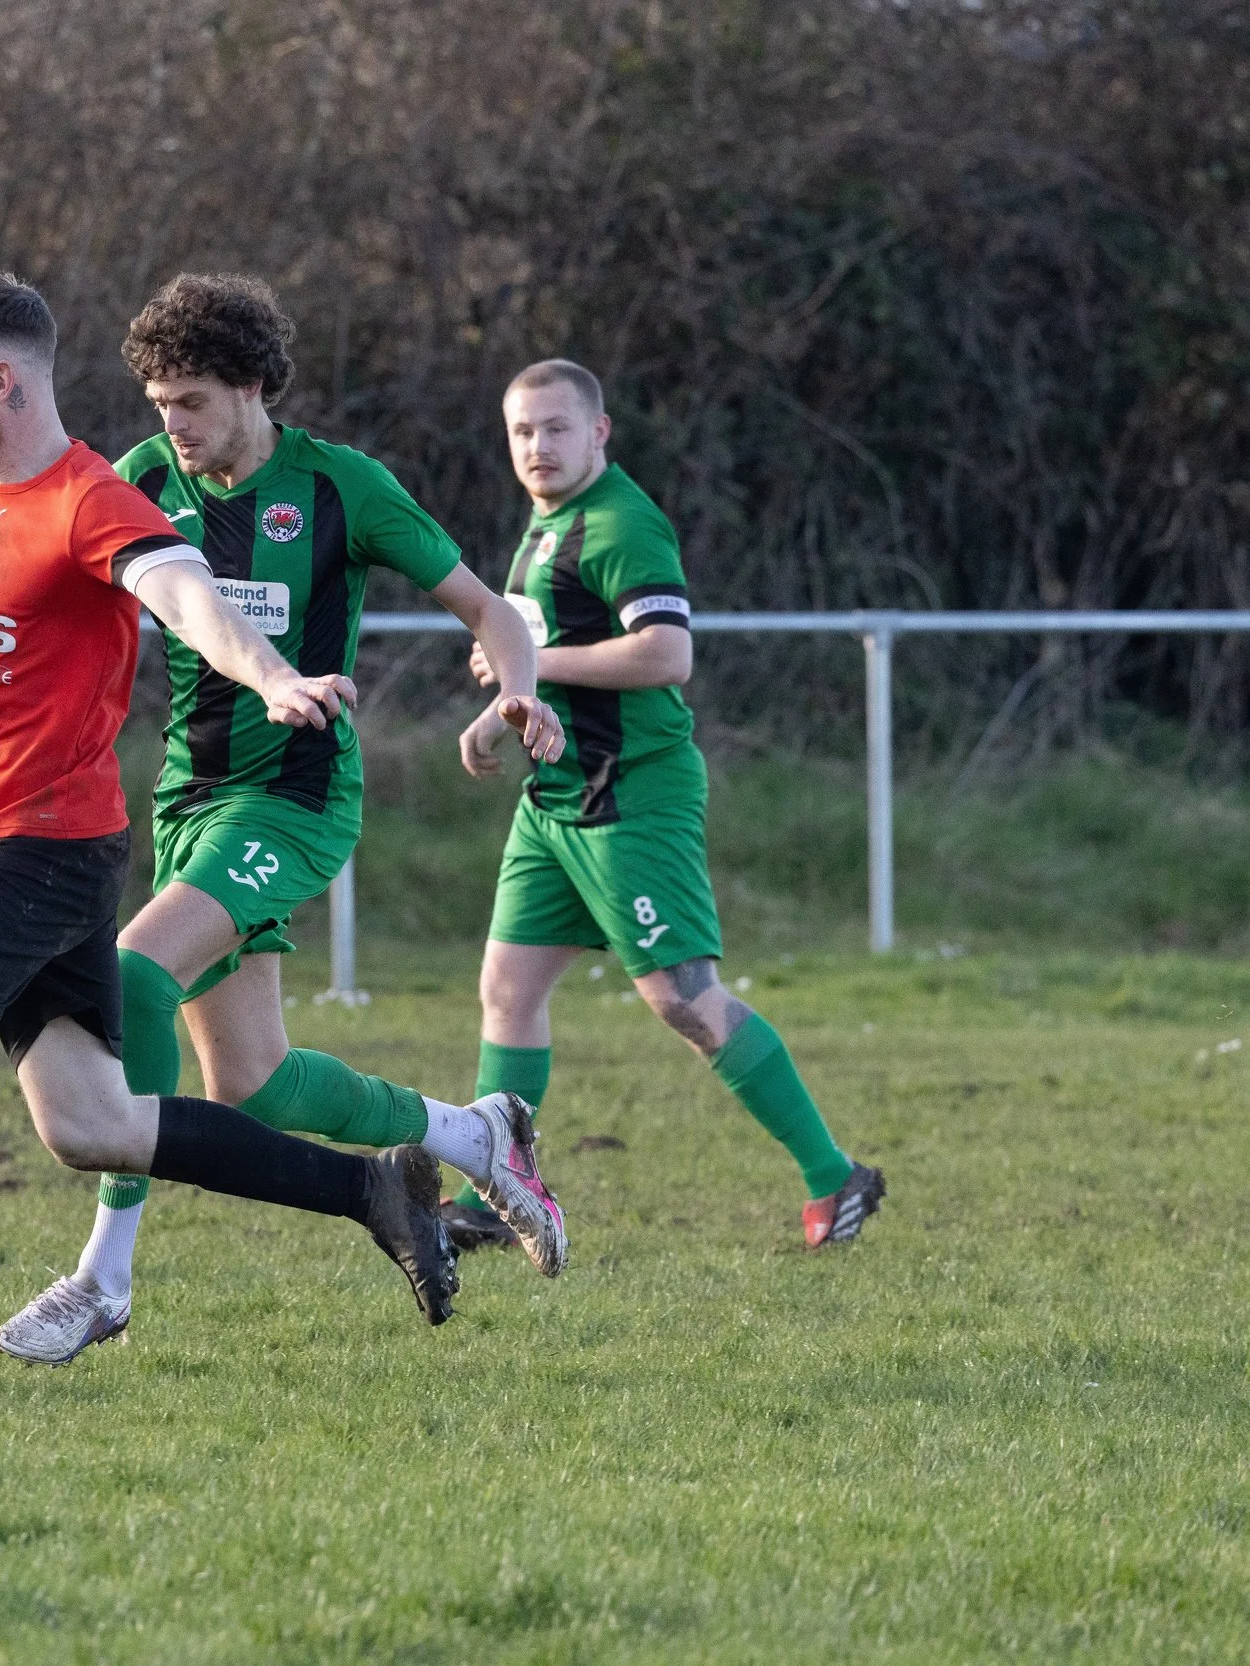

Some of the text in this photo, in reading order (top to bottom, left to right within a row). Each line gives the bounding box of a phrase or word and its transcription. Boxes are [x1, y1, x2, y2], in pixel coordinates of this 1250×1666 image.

[232, 602, 285, 617] dahs
[634, 597, 682, 613] CAPTAIN
[253, 621, 285, 630] GOLAS
[242, 841, 279, 884] 12
[633, 896, 657, 925] 8
